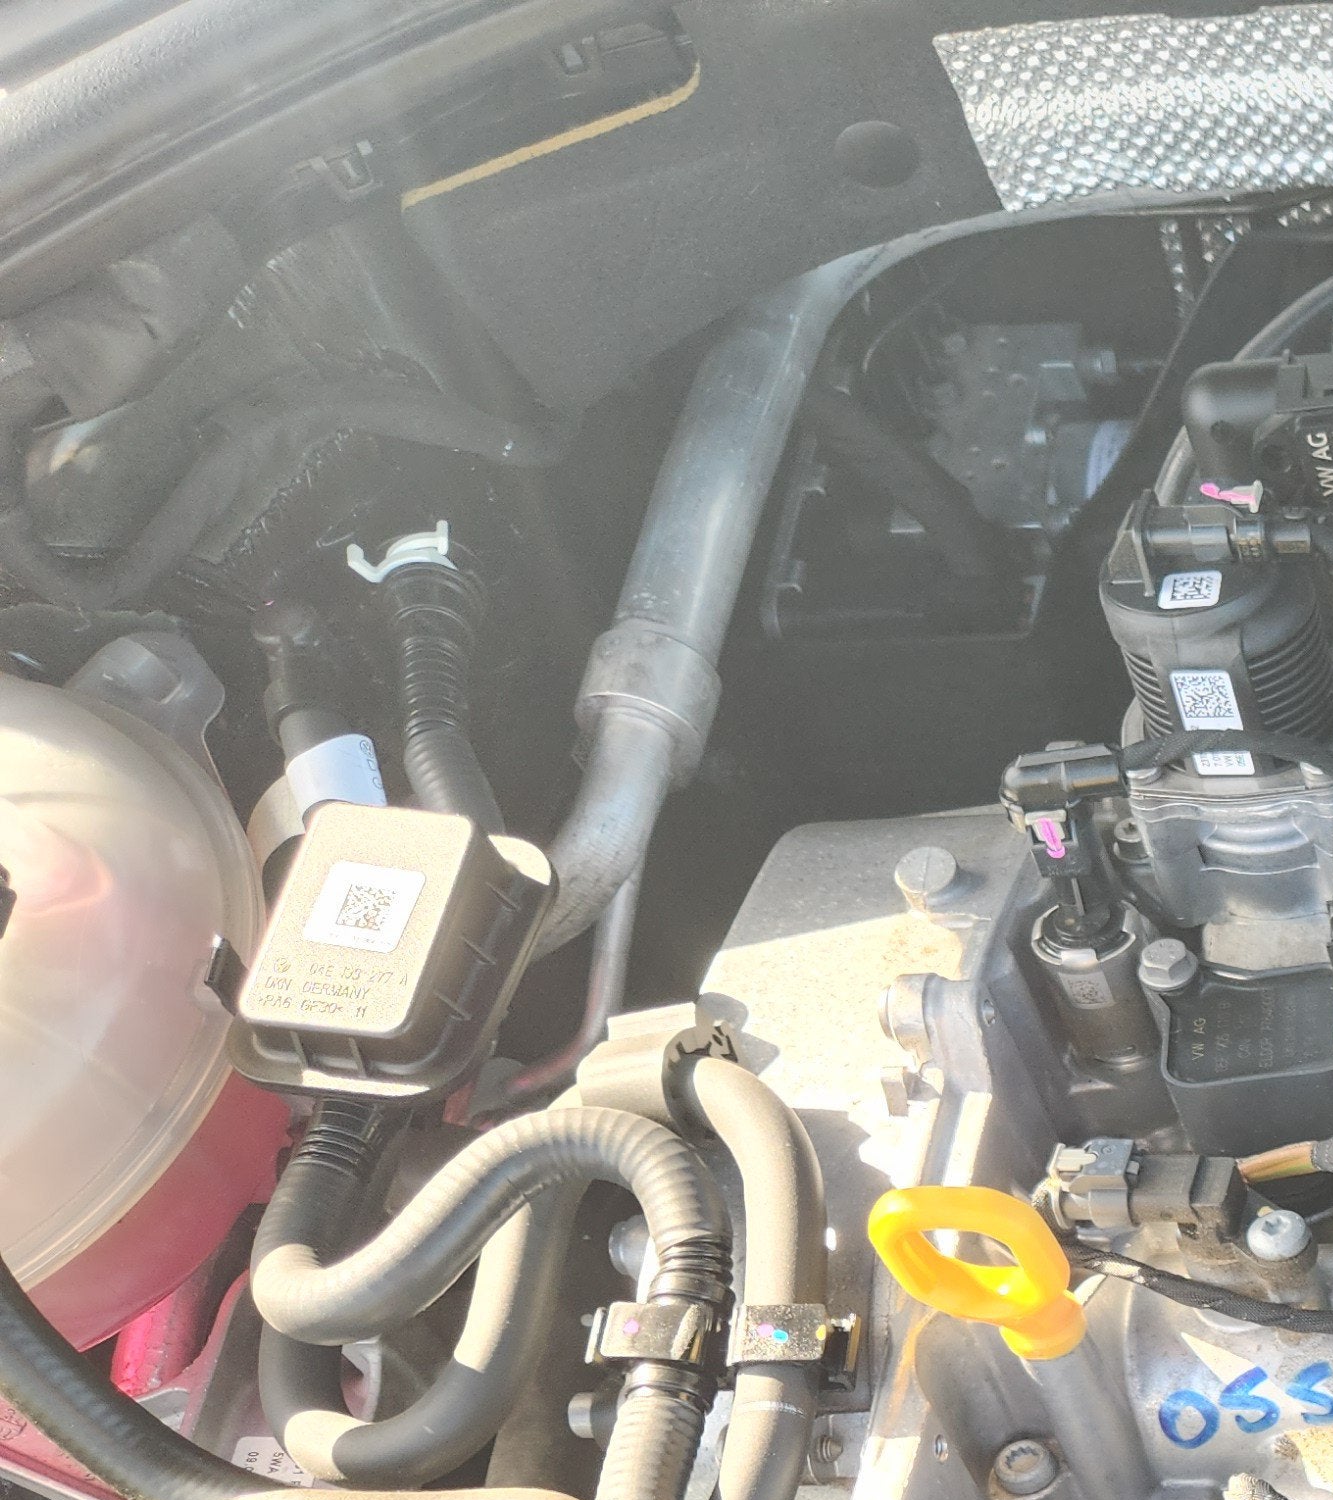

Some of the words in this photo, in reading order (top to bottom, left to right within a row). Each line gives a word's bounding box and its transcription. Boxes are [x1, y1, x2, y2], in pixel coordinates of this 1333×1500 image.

[1307, 432, 1332, 461] AG
[302, 980, 371, 1001] GERMANY
[1193, 1017, 1206, 1035] AG
[1191, 1043, 1205, 1061] VW
